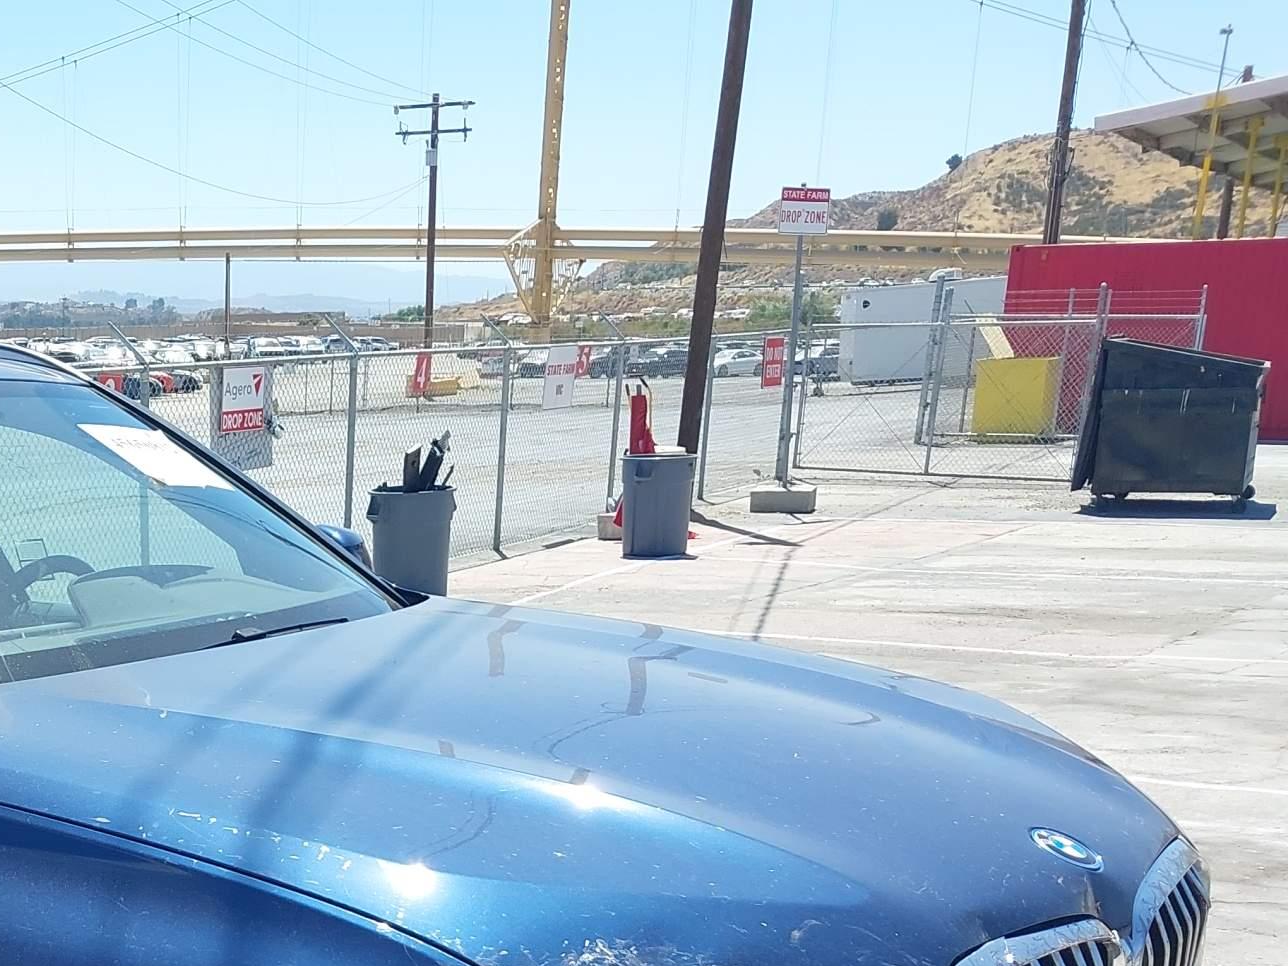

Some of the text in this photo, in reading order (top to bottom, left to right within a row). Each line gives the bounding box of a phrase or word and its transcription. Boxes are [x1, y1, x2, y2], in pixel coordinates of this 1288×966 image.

[783, 190, 829, 200] STATE FARM
[781, 210, 827, 224] DROP ZONE
[417, 357, 427, 389] 4
[224, 382, 252, 400] Agero
[222, 411, 263, 430] DROP ZONE
